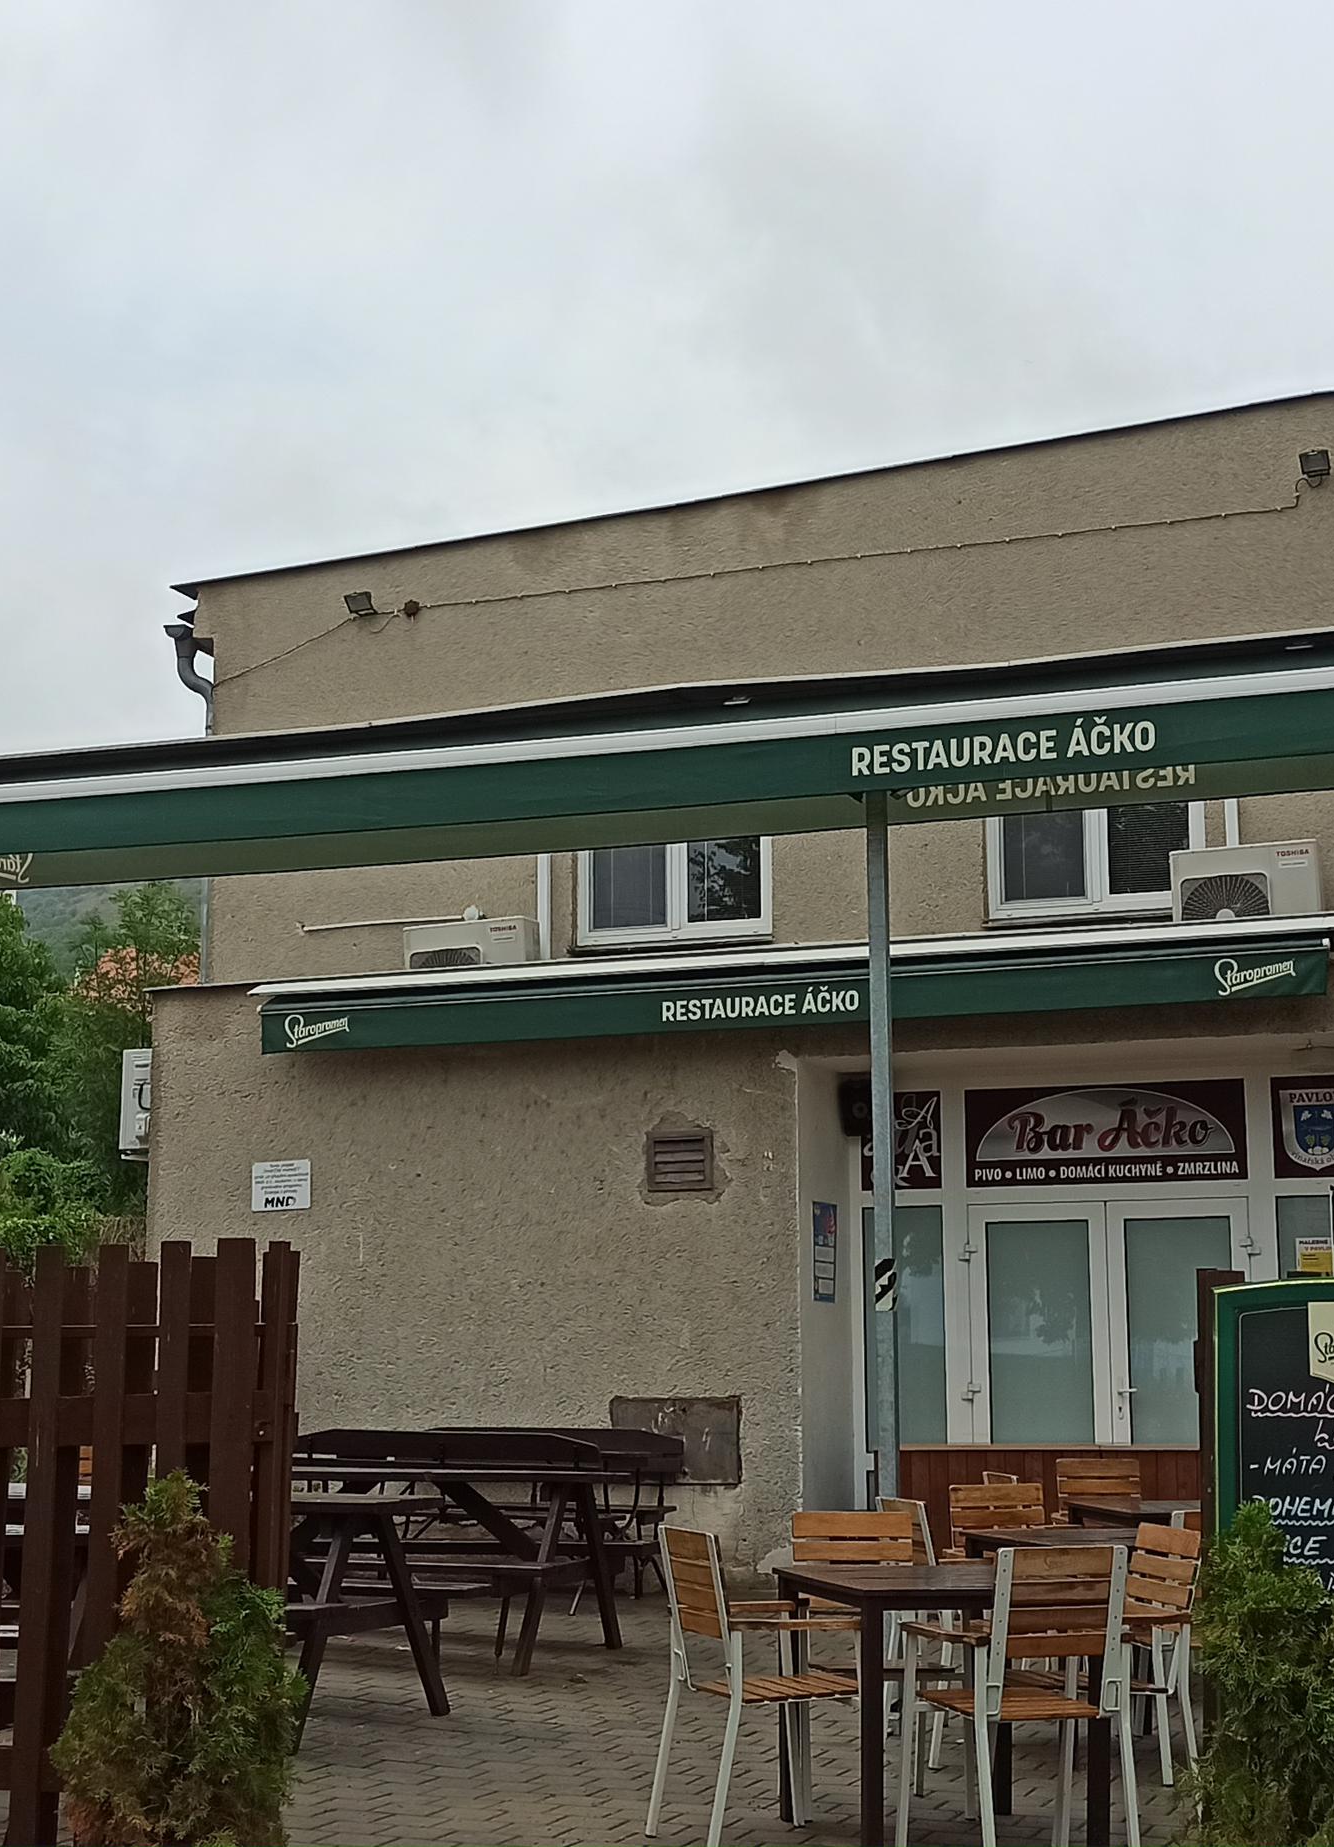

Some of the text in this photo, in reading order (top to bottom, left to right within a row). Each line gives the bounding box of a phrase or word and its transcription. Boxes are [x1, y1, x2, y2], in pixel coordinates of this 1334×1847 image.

[851, 715, 1156, 777] RESTAURACE ÁČKO
[1276, 849, 1309, 857] TOSHIBA
[490, 925, 517, 933] TOSHIBA
[1214, 958, 1296, 996] Staropramen
[661, 985, 860, 1022] RESTAURACE ÁČKO
[284, 1014, 350, 1048] Staropramen
[1007, 1096, 1216, 1154] Bar Áčko
[974, 1160, 1240, 1182] PIVO LIMO DOMÁCÍ KUCHYNĚ ZMRZLINA
[264, 1196, 297, 1208] MND
